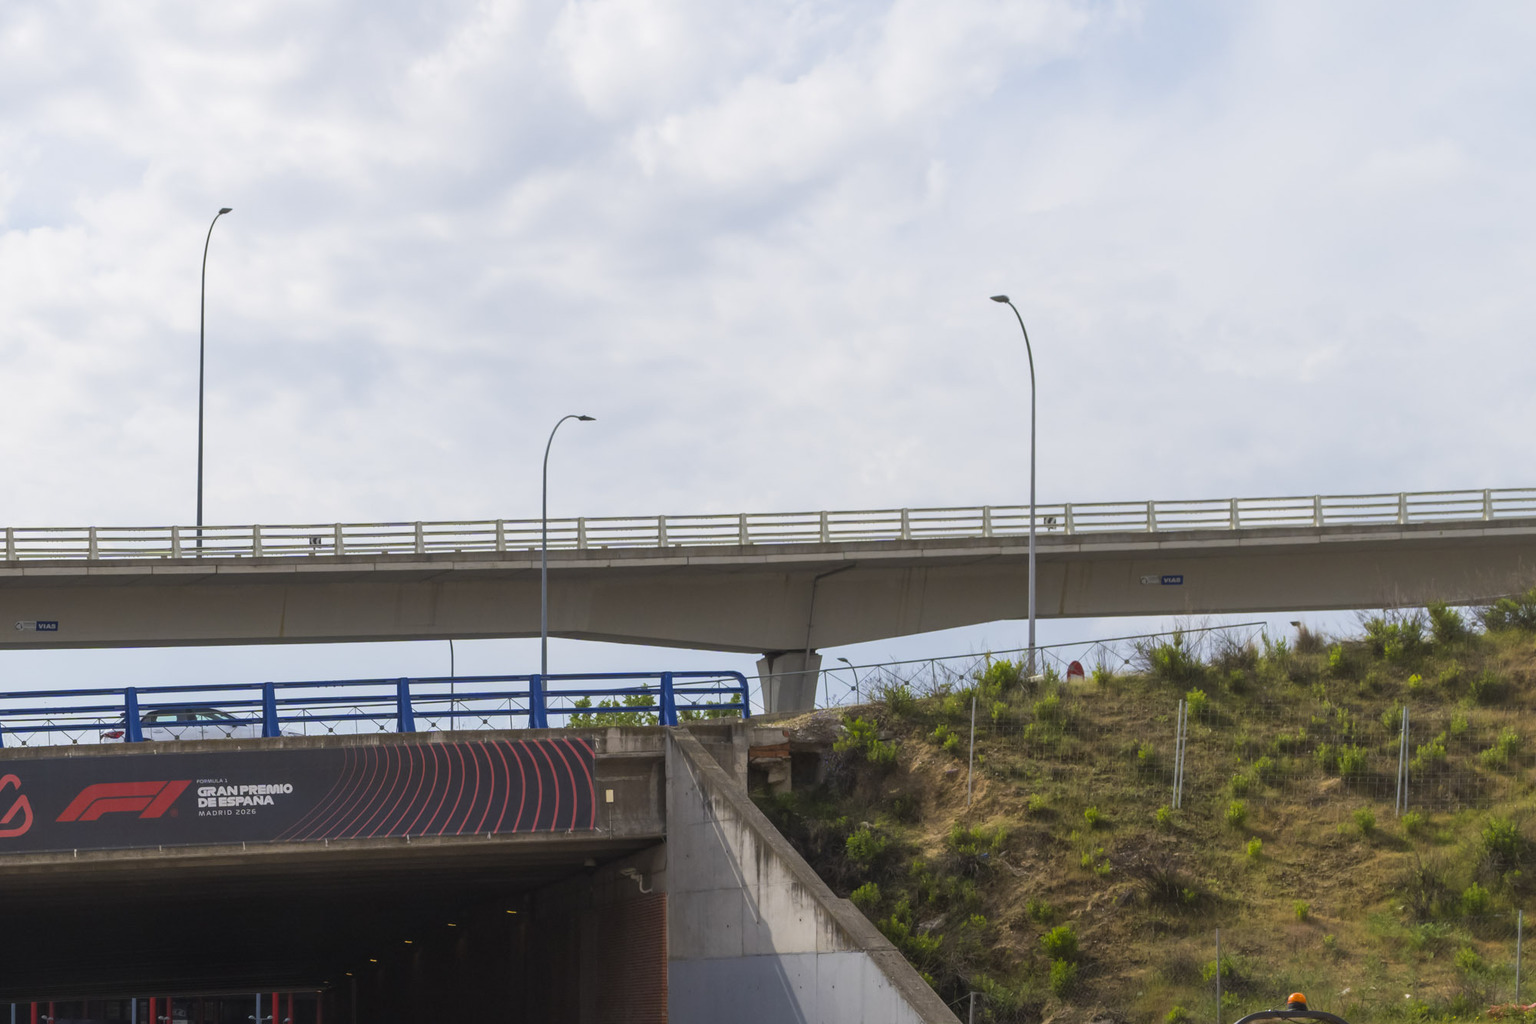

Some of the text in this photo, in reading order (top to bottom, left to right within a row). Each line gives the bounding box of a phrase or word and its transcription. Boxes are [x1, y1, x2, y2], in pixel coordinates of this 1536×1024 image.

[197, 783, 294, 797] GRAN PREMIO
[56, 780, 192, 822] F1
[197, 797, 217, 808] DE
[198, 809, 233, 817] MADRID
